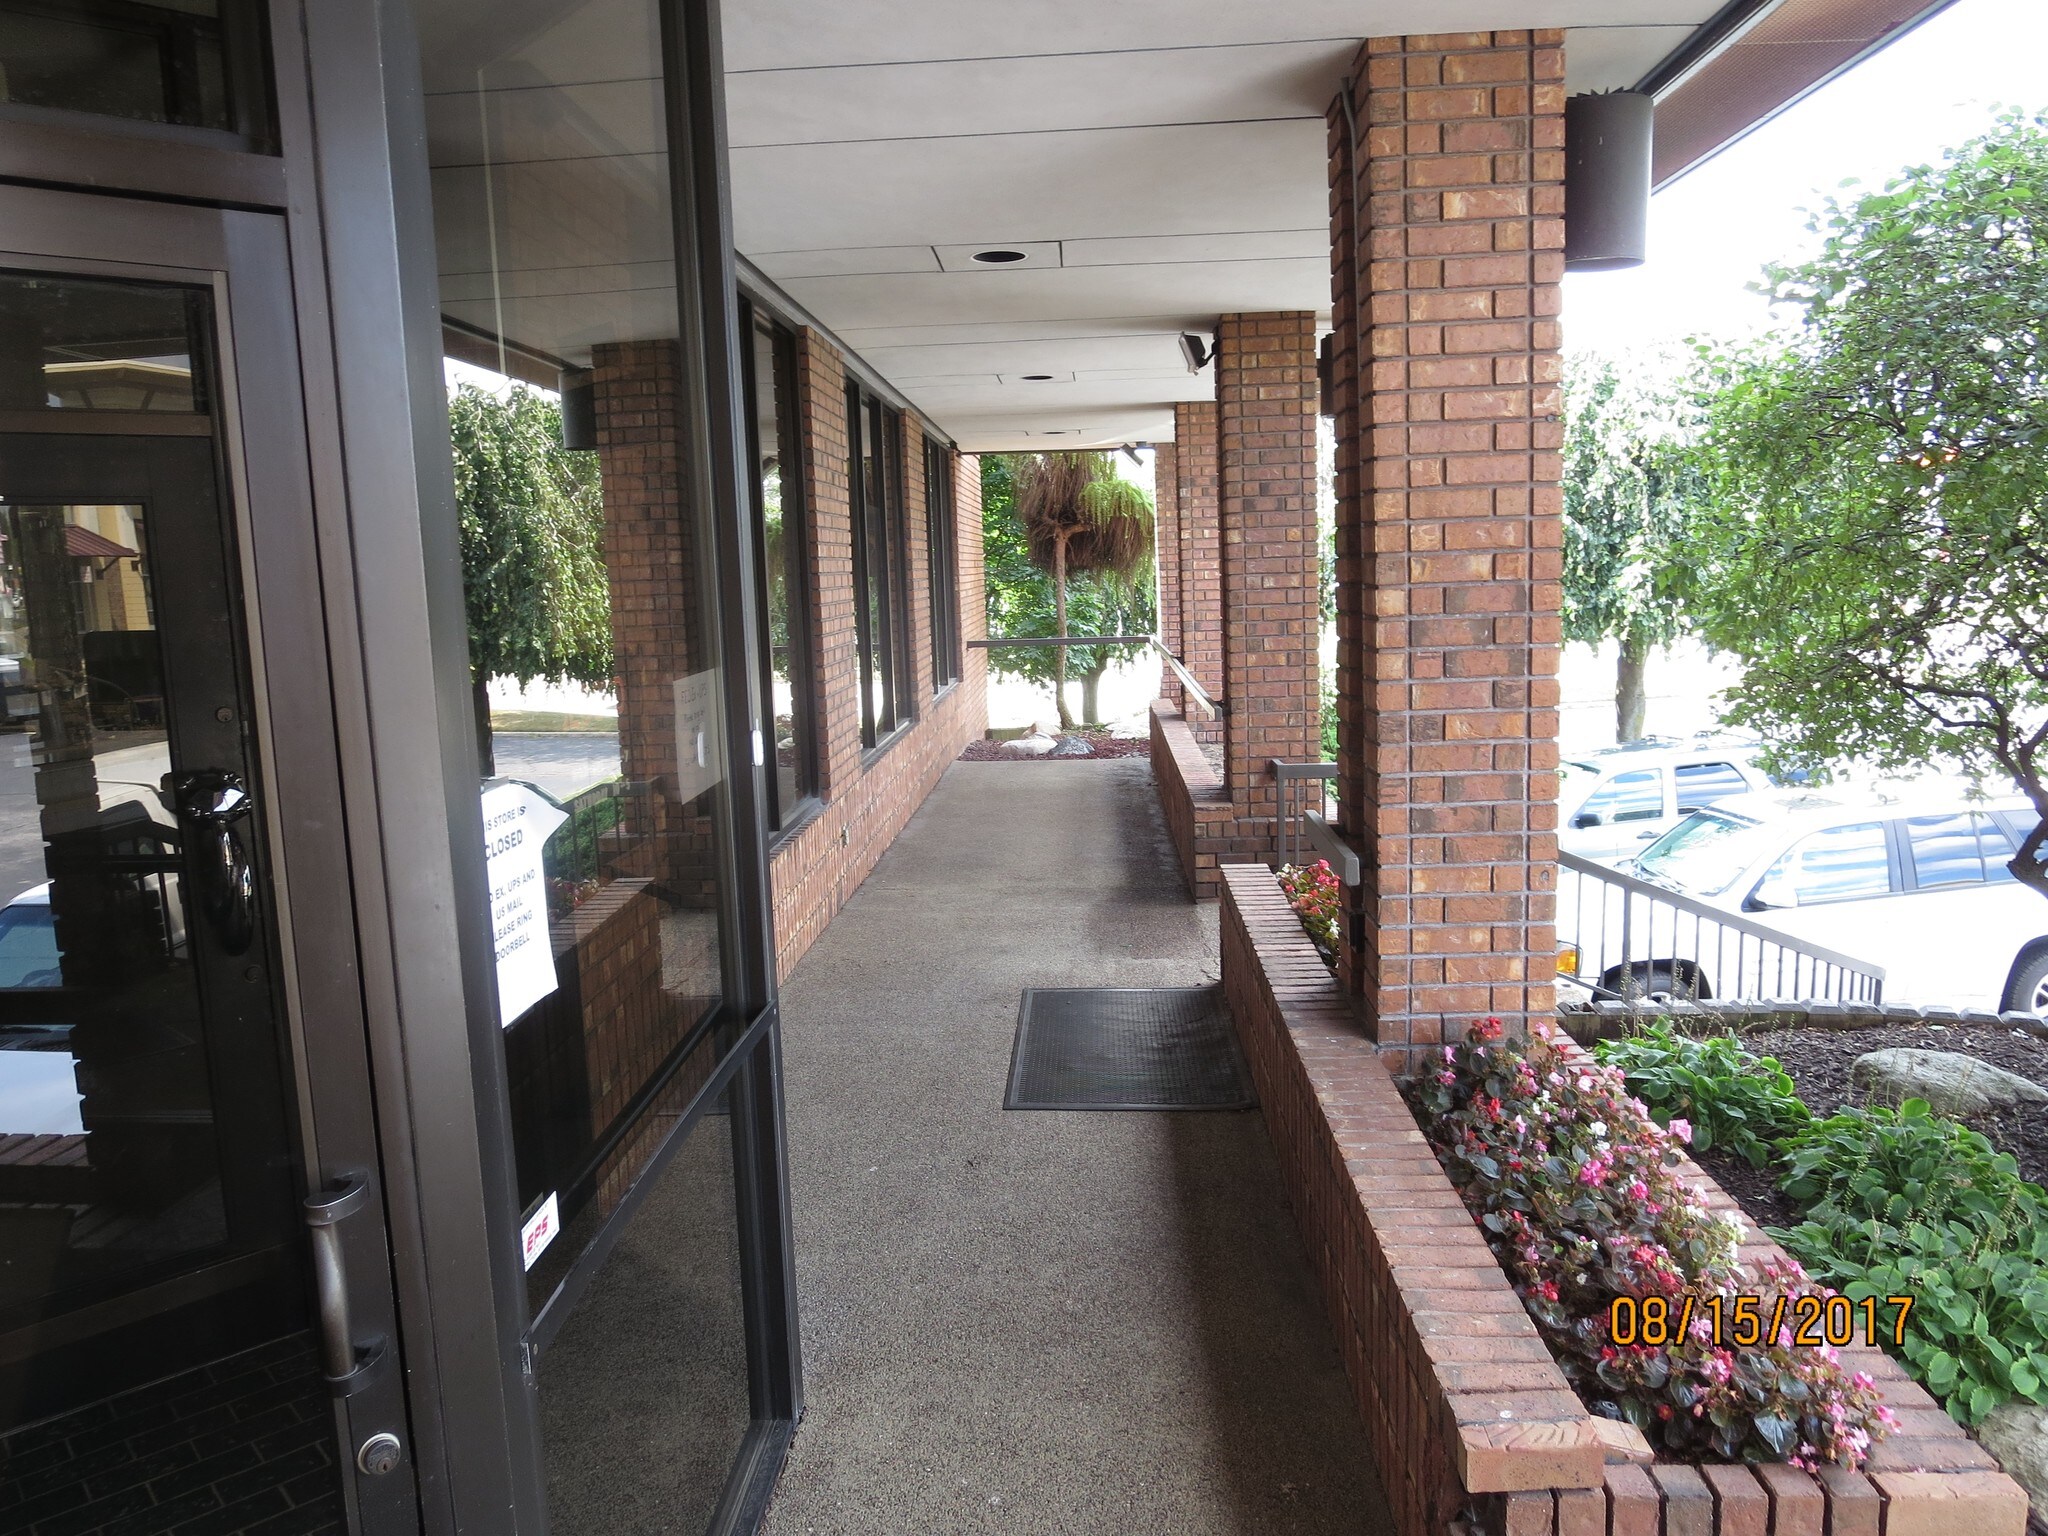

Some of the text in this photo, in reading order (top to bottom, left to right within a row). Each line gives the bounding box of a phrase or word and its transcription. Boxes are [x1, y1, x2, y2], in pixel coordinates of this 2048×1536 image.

[493, 809, 515, 828] STORE
[517, 805, 527, 817] IS
[484, 829, 523, 861] CLOSED
[507, 877, 521, 892] UPS
[523, 869, 535, 884] AND
[496, 906, 505, 920] US
[507, 897, 523, 913] MAIL
[494, 909, 533, 942] LEASE RING
[495, 931, 530, 963] DOORBELL
